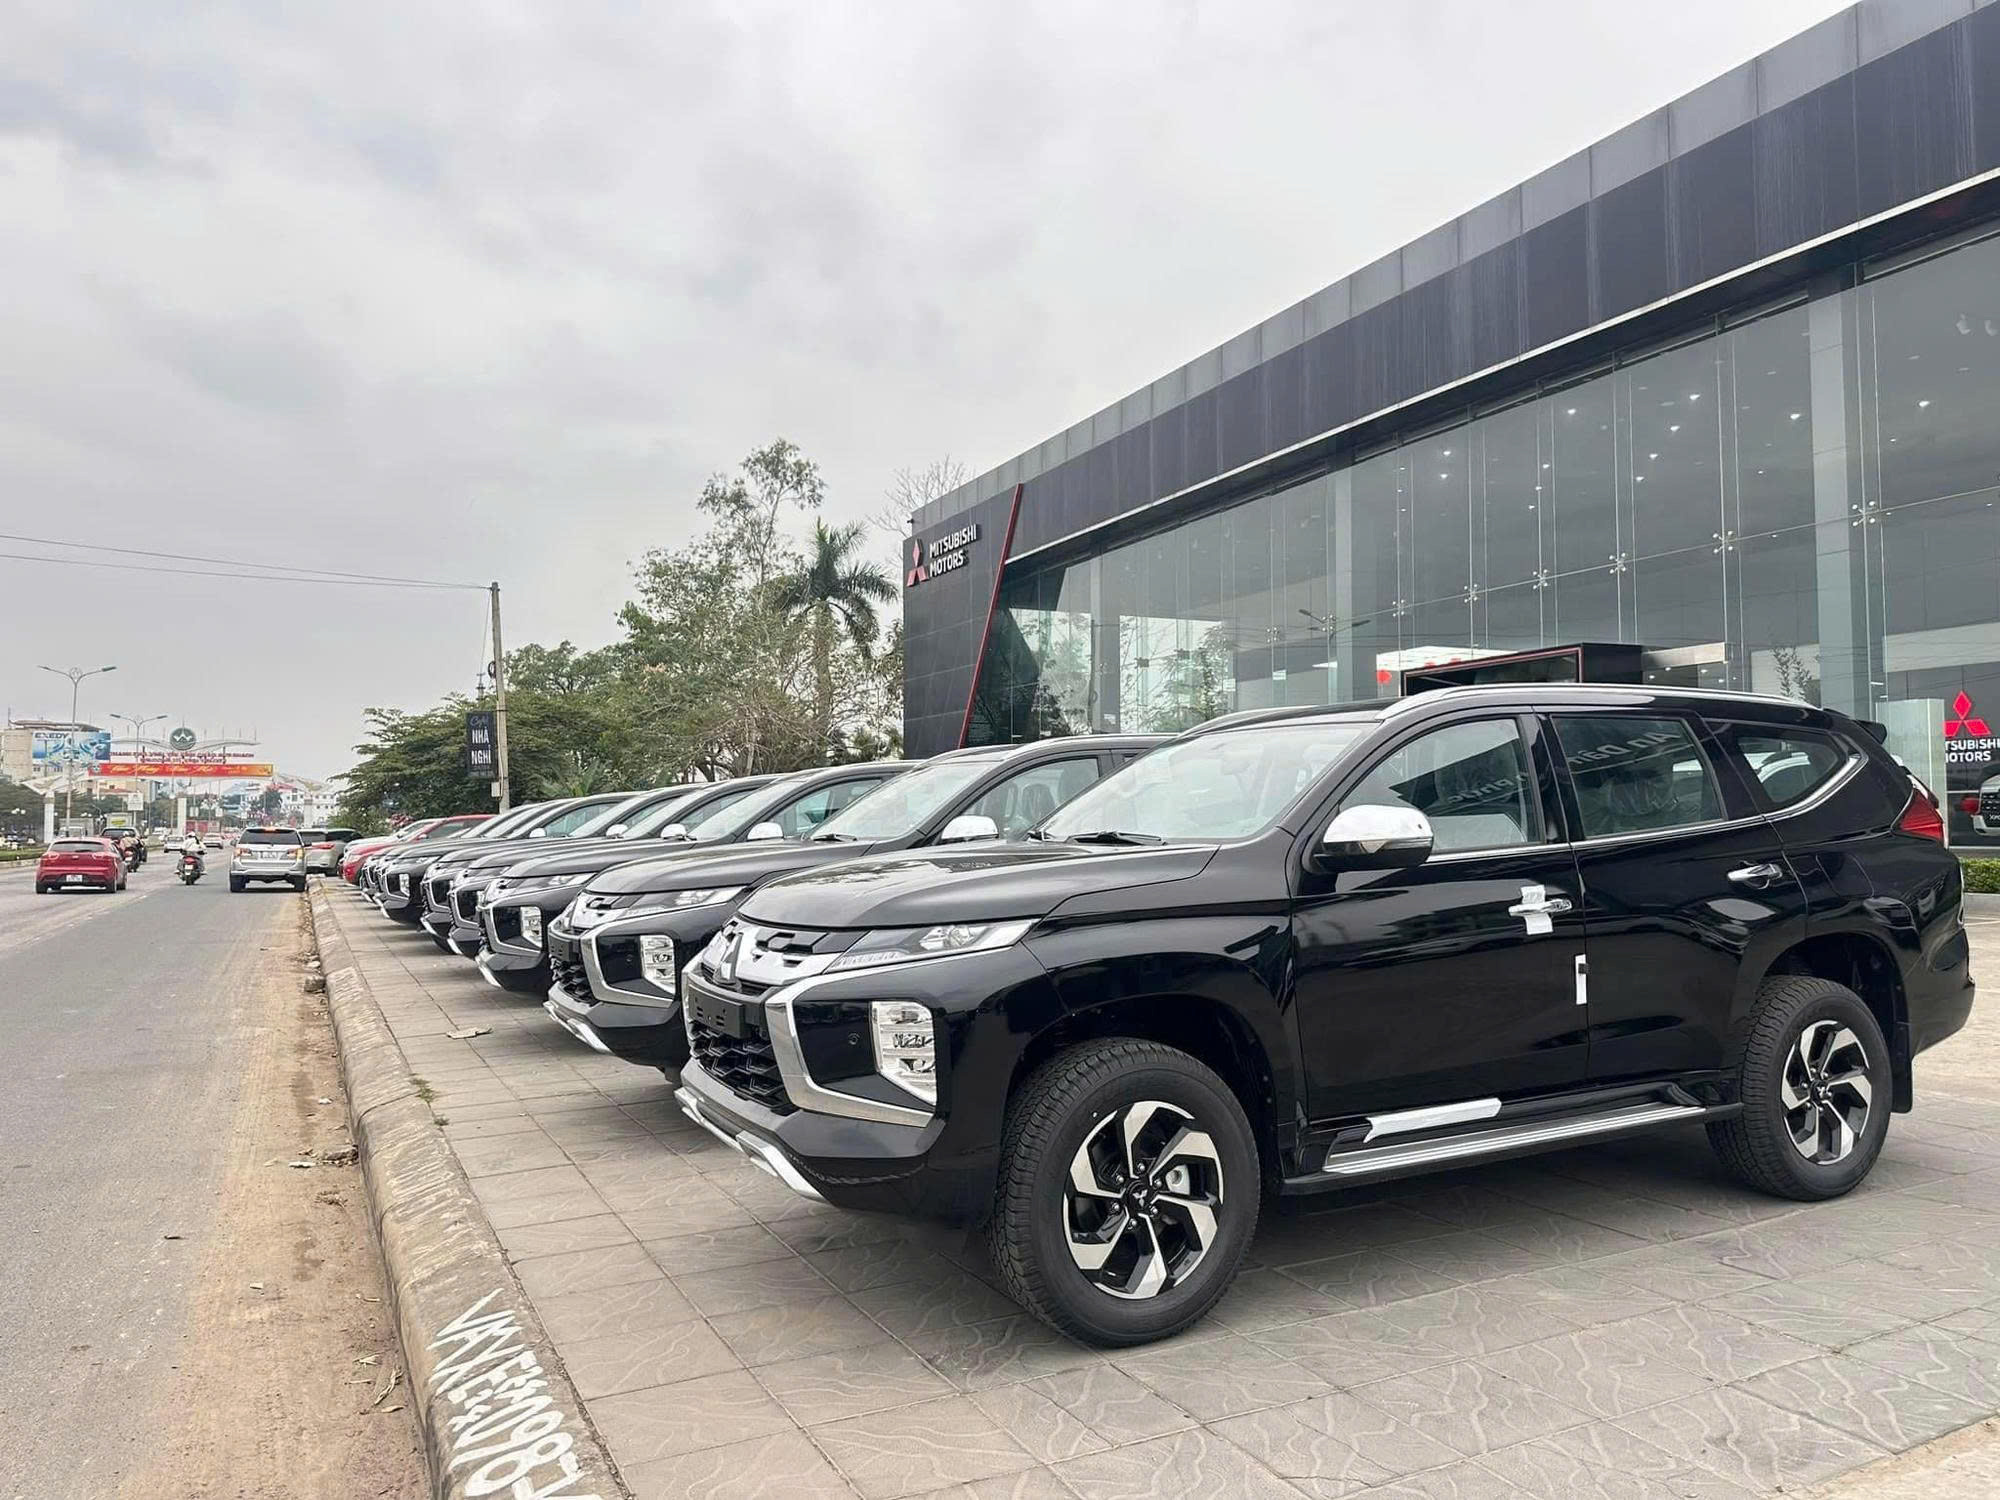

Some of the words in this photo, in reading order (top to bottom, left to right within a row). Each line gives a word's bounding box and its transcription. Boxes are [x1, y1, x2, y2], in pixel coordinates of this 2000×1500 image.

[929, 523, 977, 558] MITSUBISHI
[929, 550, 964, 578] MOTORS
[1945, 738, 2000, 751] TSUBISHI
